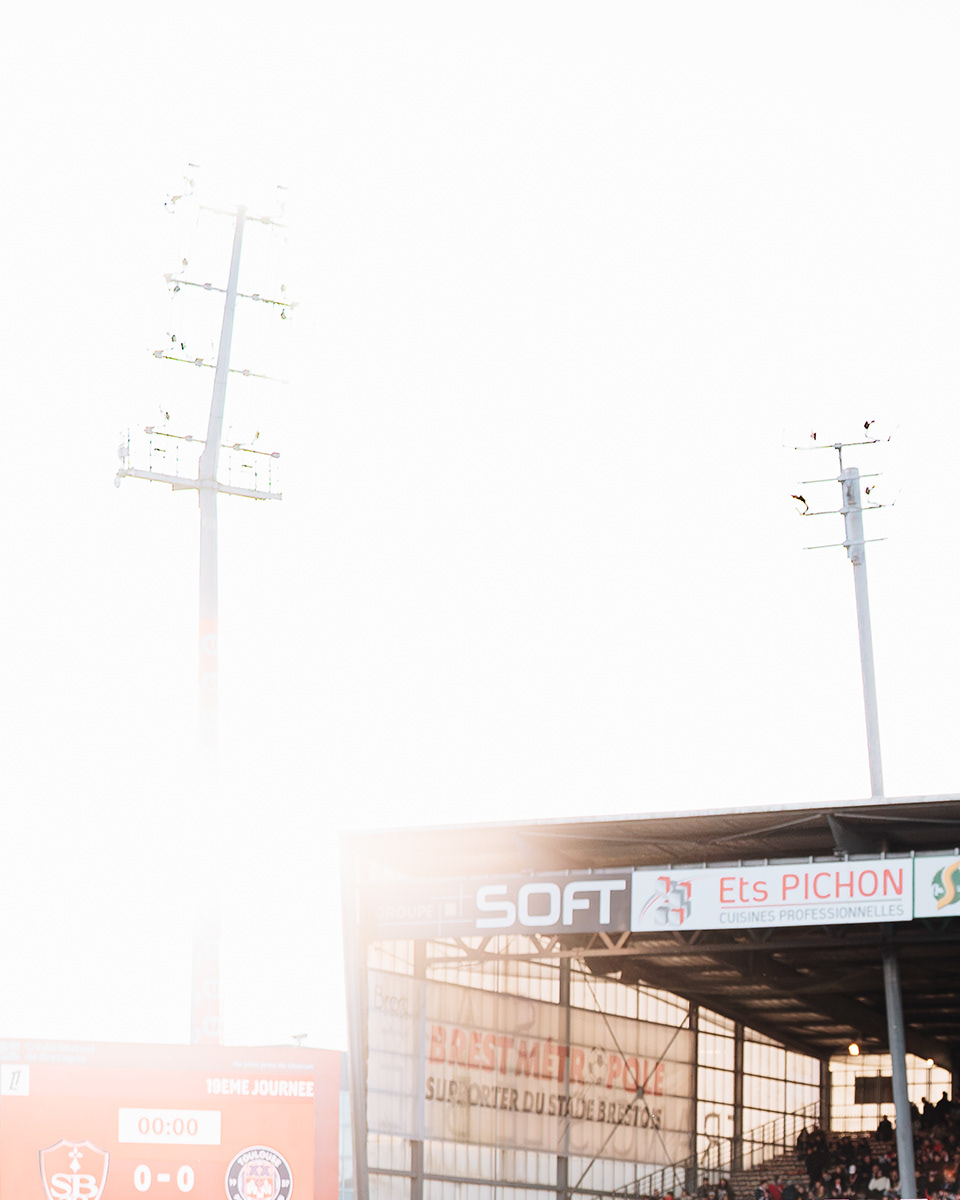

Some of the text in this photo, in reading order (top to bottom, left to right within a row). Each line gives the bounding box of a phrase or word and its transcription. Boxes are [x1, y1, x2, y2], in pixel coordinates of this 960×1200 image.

[719, 868, 904, 904] Ets PICHON
[475, 880, 627, 929] SOFT
[719, 904, 905, 924] CUISINES PROFESSIONNELLES
[428, 1025, 514, 1077] BREST
[206, 1078, 315, 1097] 19EME JOURNEE
[425, 1077, 662, 1130] SUPPORTER DU STADE BRESTOIS
[138, 1117, 198, 1136] 00:00
[50, 1172, 99, 1199] SB
[133, 1164, 152, 1192] 0
[177, 1165, 195, 1193] 0
